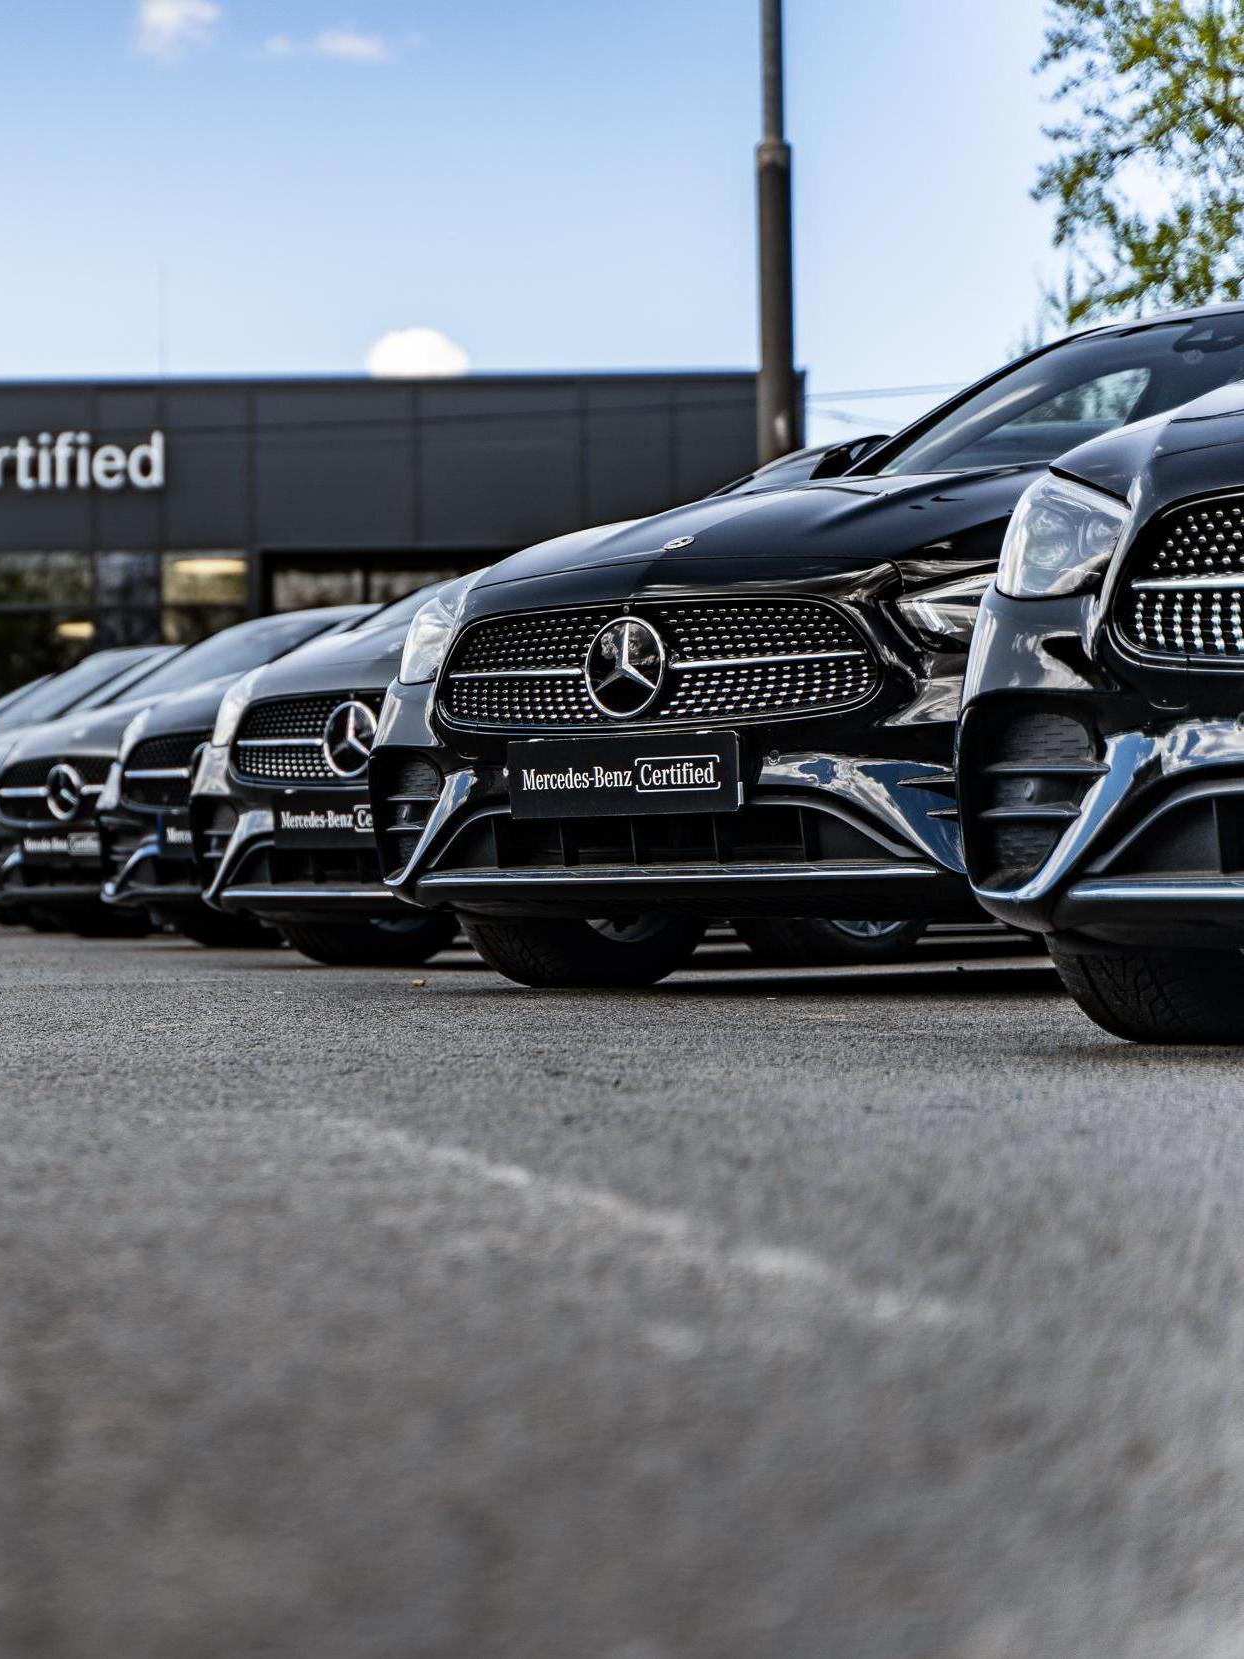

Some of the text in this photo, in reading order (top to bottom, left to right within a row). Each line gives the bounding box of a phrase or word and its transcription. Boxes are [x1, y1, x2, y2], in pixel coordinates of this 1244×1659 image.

[522, 761, 715, 791] Mercedes-Benz Certified
[280, 810, 354, 829] Mercedes-Benz
